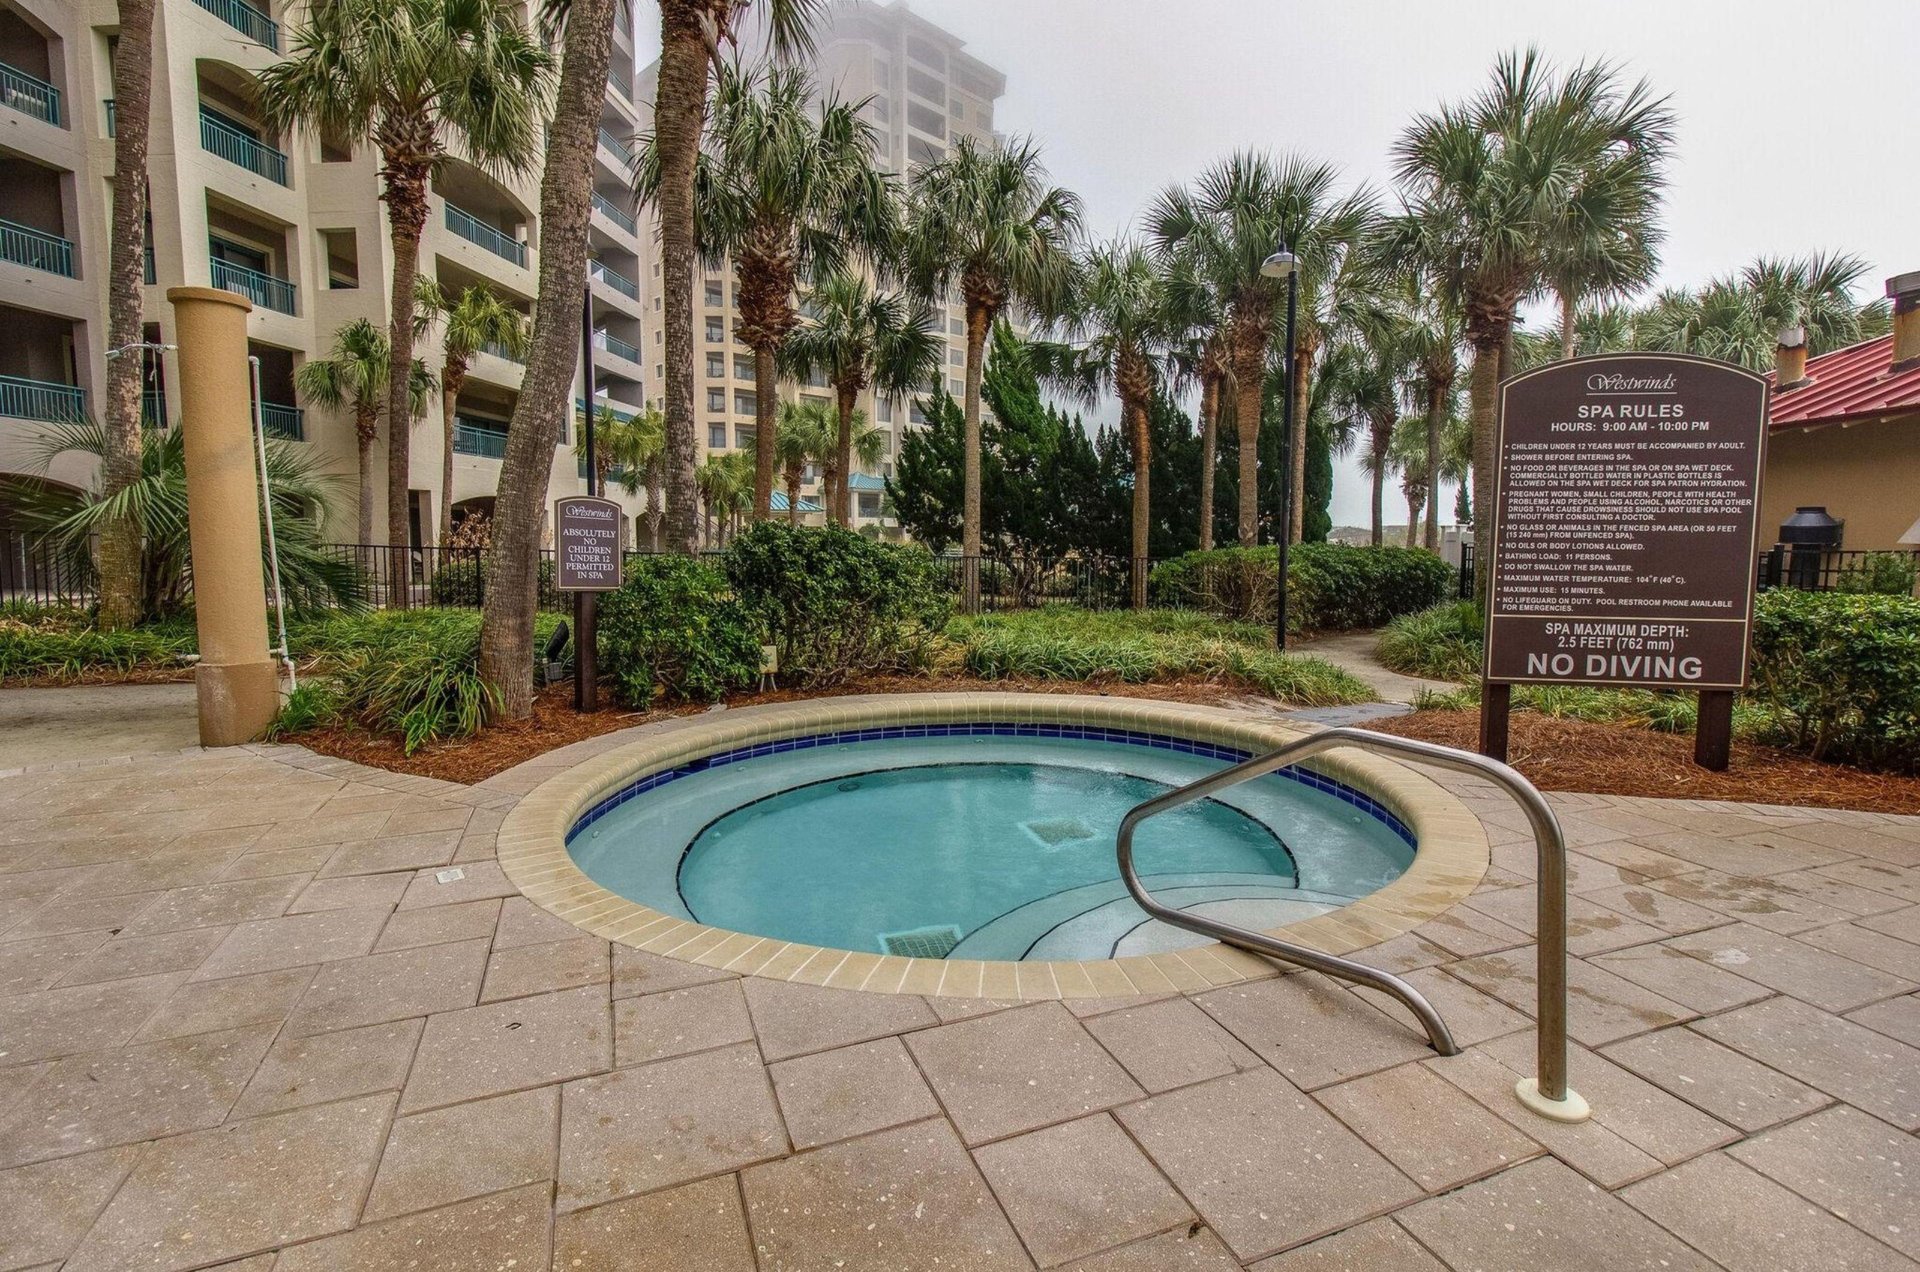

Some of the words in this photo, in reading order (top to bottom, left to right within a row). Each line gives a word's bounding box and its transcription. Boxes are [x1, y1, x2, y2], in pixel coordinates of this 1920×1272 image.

[1586, 373, 1677, 390] Westwinds
[1577, 405, 1615, 418] SPA
[1620, 404, 1684, 418] RULES
[1551, 422, 1596, 431] HOURS:
[1603, 422, 1626, 431] 9:00
[1629, 422, 1647, 431] AM
[1658, 421, 1688, 431] 10:00
[1691, 421, 1709, 431] PM
[566, 505, 612, 518] Westwinds
[563, 528, 616, 538] ABSOLUTELY
[1690, 525, 1704, 533] (OR
[568, 545, 612, 554] CHILDREN
[570, 554, 600, 562] UNDER
[603, 555, 610, 563] 12
[566, 562, 614, 571] PERMITTED
[577, 571, 588, 579] IN
[1504, 574, 1540, 582] MAXIMUM
[1545, 623, 1570, 635] SPA
[1574, 624, 1637, 636] MAXIMUM
[1640, 625, 1689, 638] DEPTH:
[1558, 636, 1576, 648] 2.5
[1580, 637, 1613, 649] FEET
[1616, 638, 1643, 651] (762
[1527, 653, 1574, 676] NO
[1586, 654, 1703, 679] DIVING
